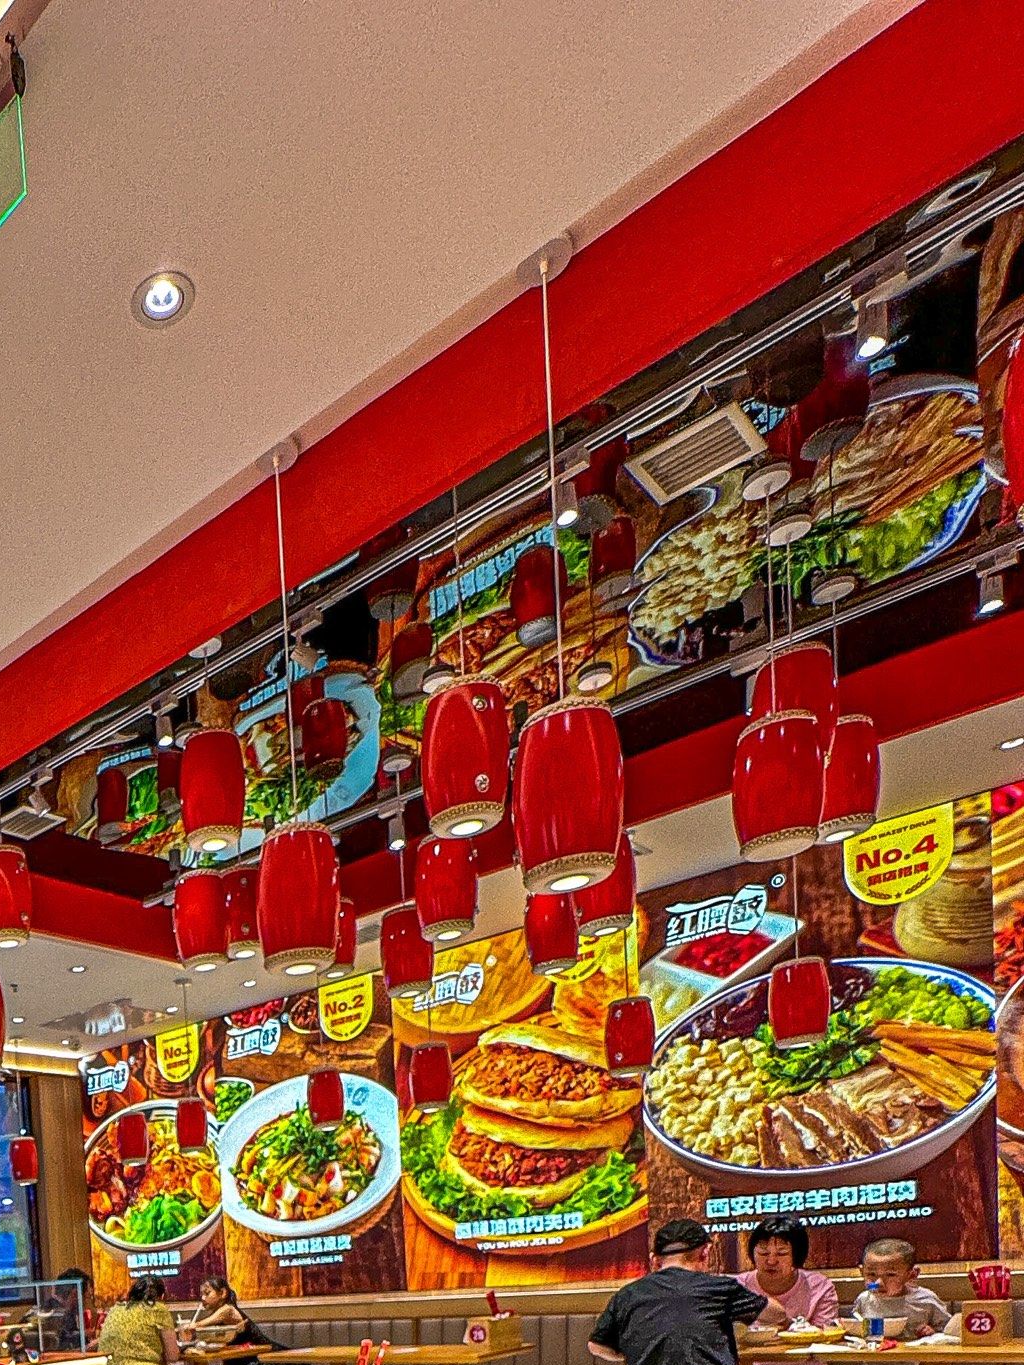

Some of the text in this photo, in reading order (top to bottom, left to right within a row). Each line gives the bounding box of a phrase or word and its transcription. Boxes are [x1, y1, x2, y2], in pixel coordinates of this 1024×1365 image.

[856, 834, 938, 873] No.4
[324, 995, 365, 1017] No.2
[706, 1180, 917, 1218] 西安传统羊肉泡馍
[909, 1206, 932, 1217] MO
[971, 1317, 991, 1331] 23
